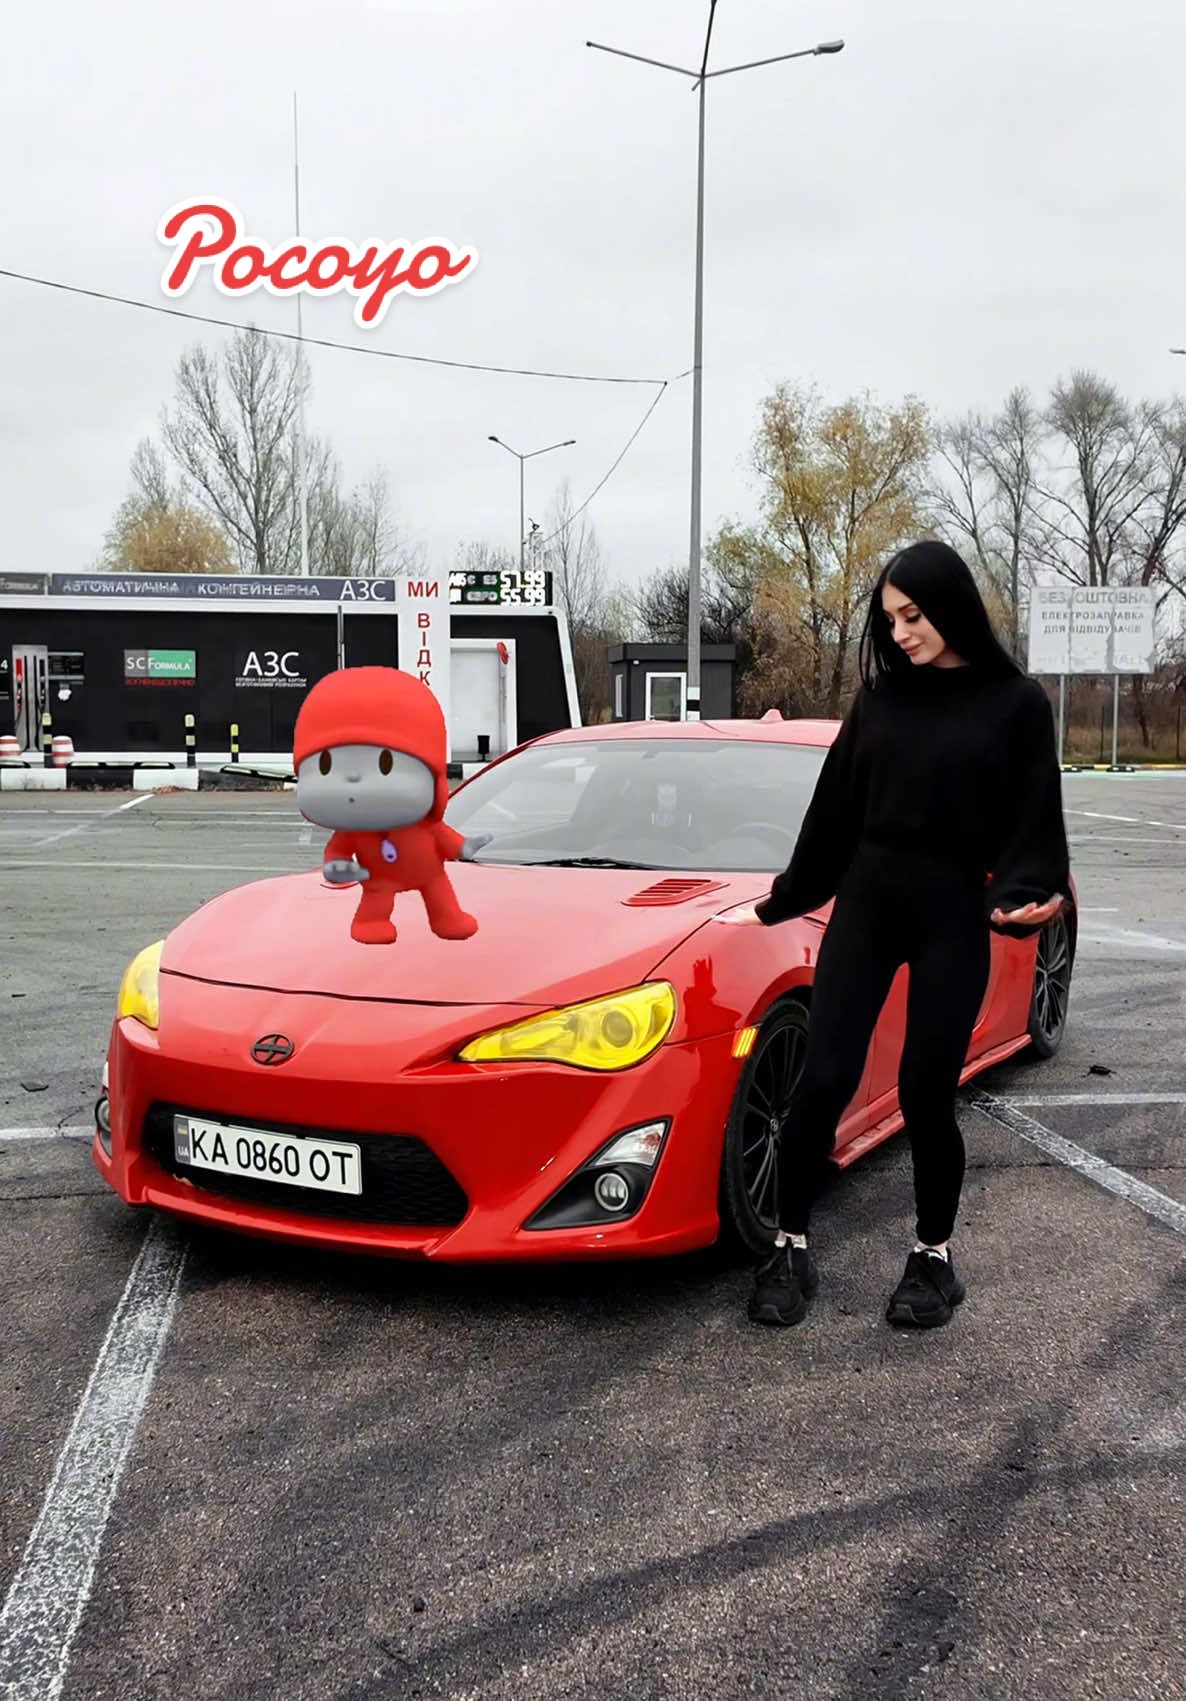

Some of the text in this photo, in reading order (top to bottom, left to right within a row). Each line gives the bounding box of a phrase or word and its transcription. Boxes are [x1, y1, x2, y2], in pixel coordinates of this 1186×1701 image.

[62, 579, 182, 594] АВТОМАТИЧНА
[339, 579, 387, 601] АЗС
[407, 581, 439, 598] МИ
[1039, 591, 1150, 605] БЕЗОШТОВНА
[242, 651, 300, 677] АЗС
[191, 1128, 354, 1185] KA 0860 OT
